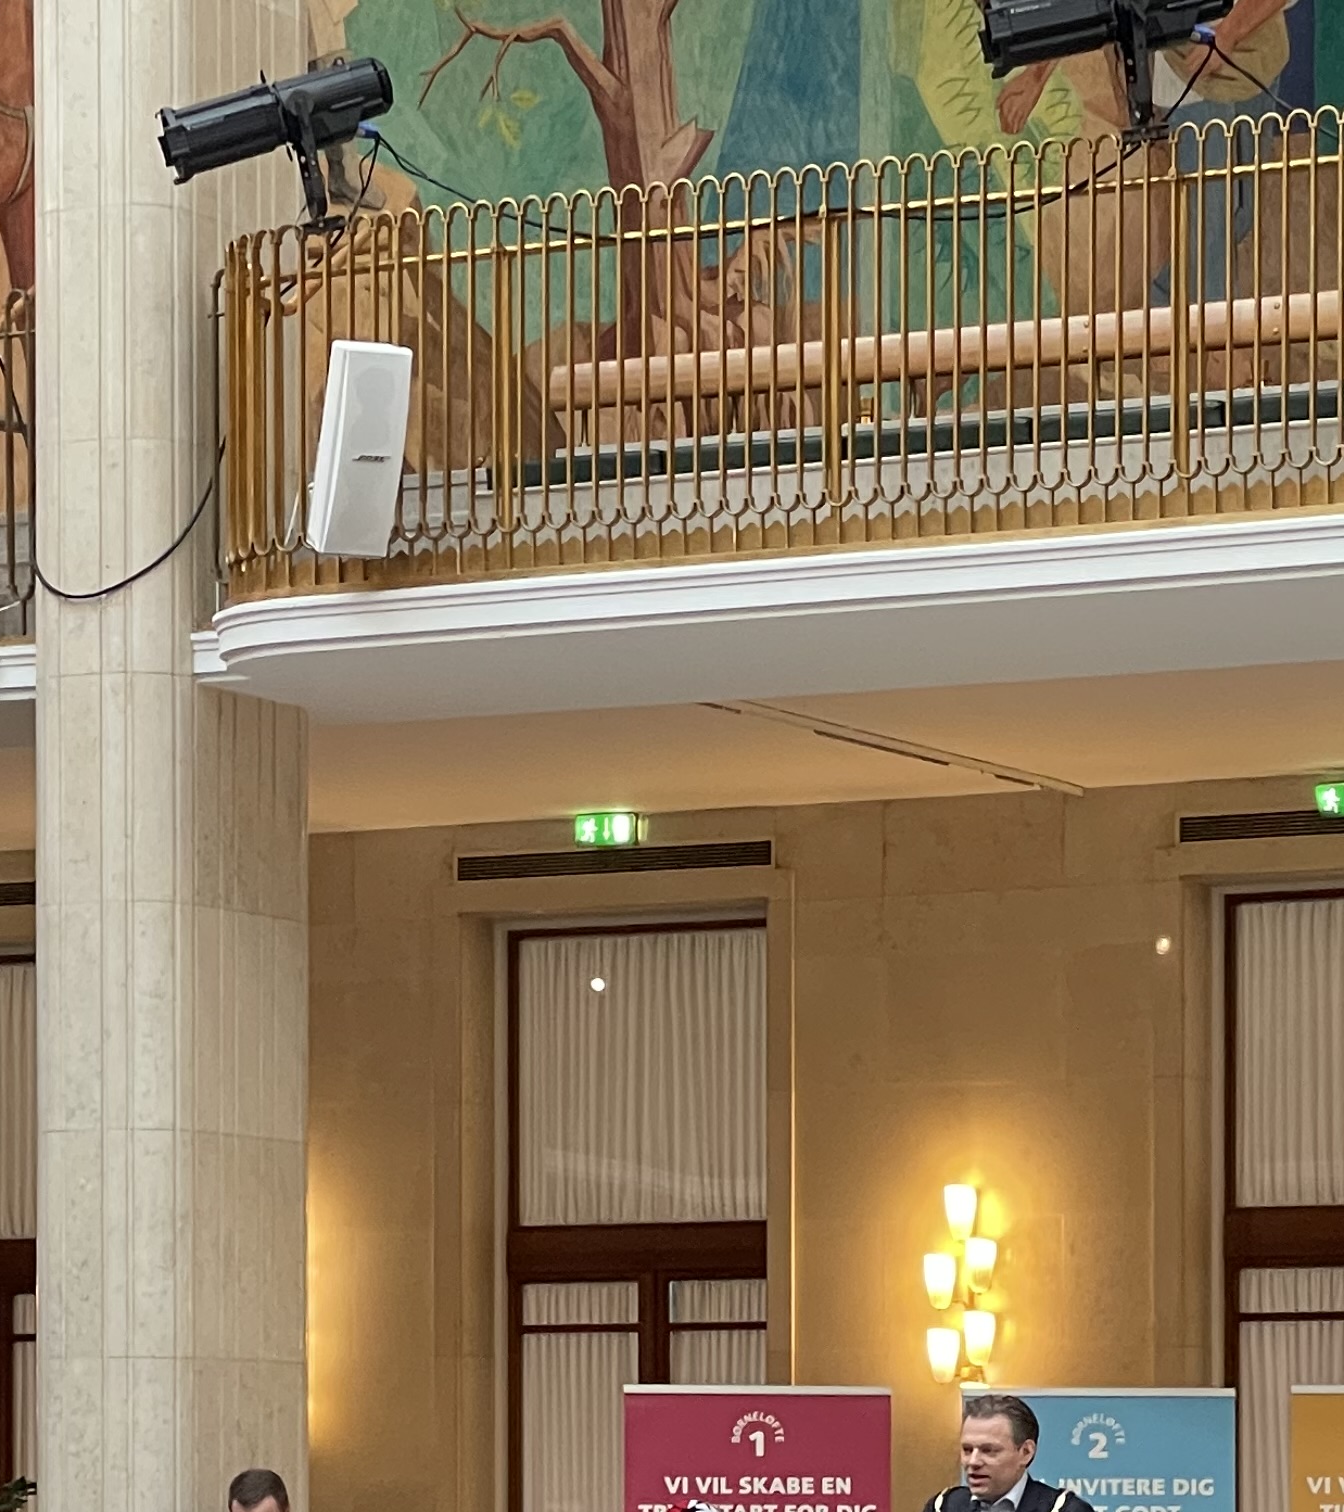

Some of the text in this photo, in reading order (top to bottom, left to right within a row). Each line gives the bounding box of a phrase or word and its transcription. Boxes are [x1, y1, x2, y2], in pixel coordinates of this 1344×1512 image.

[748, 1431, 765, 1457] 1
[1088, 1432, 1109, 1459] 2
[664, 1476, 852, 1495] VI VIL SKABE EN
[1058, 1477, 1215, 1497] INVITERE DIG
[1306, 1476, 1331, 1495] VI
